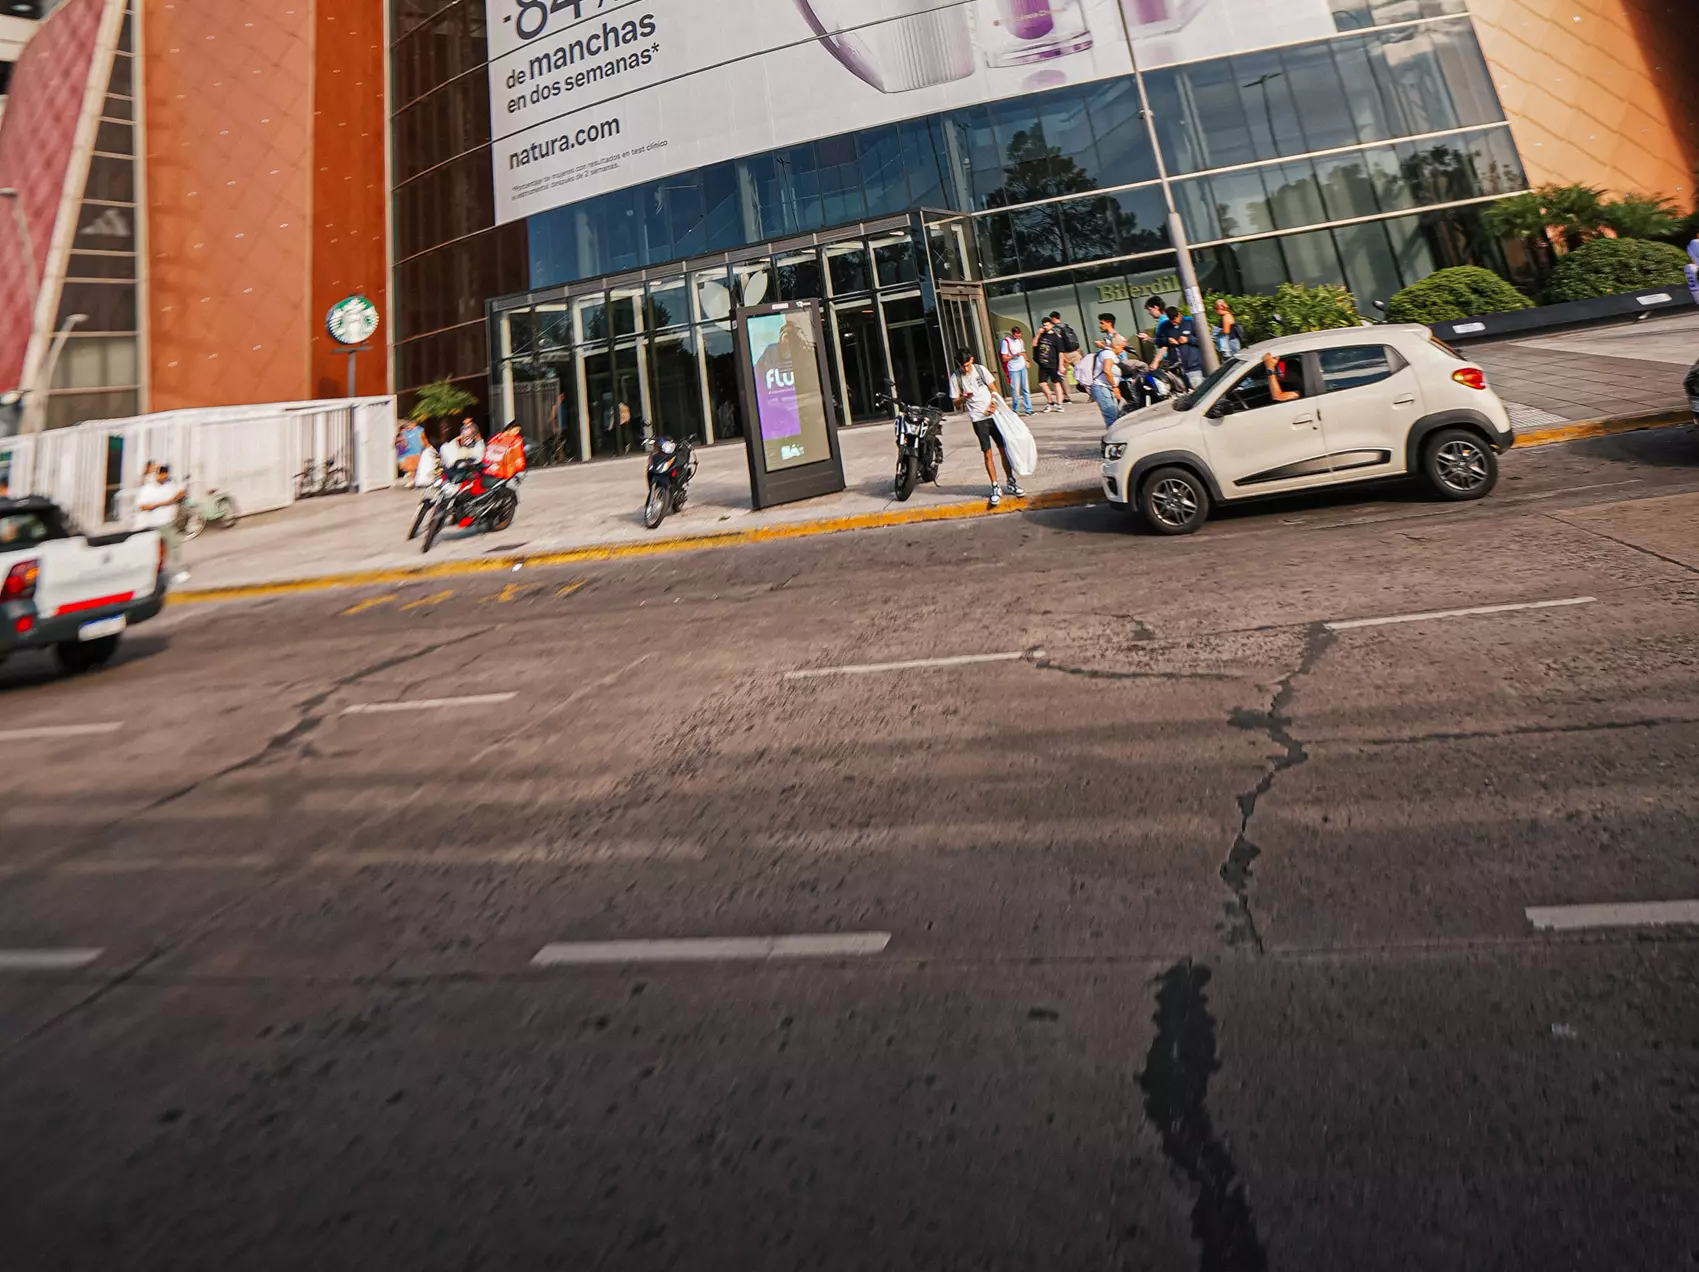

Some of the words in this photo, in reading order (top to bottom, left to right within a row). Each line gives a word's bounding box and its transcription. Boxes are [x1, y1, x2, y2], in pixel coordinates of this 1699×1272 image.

[506, 69, 526, 89] de
[529, 13, 656, 80] manchas
[507, 94, 527, 113] en
[530, 80, 561, 105] dos
[509, 117, 620, 170] natura.com
[631, 146, 645, 156] test
